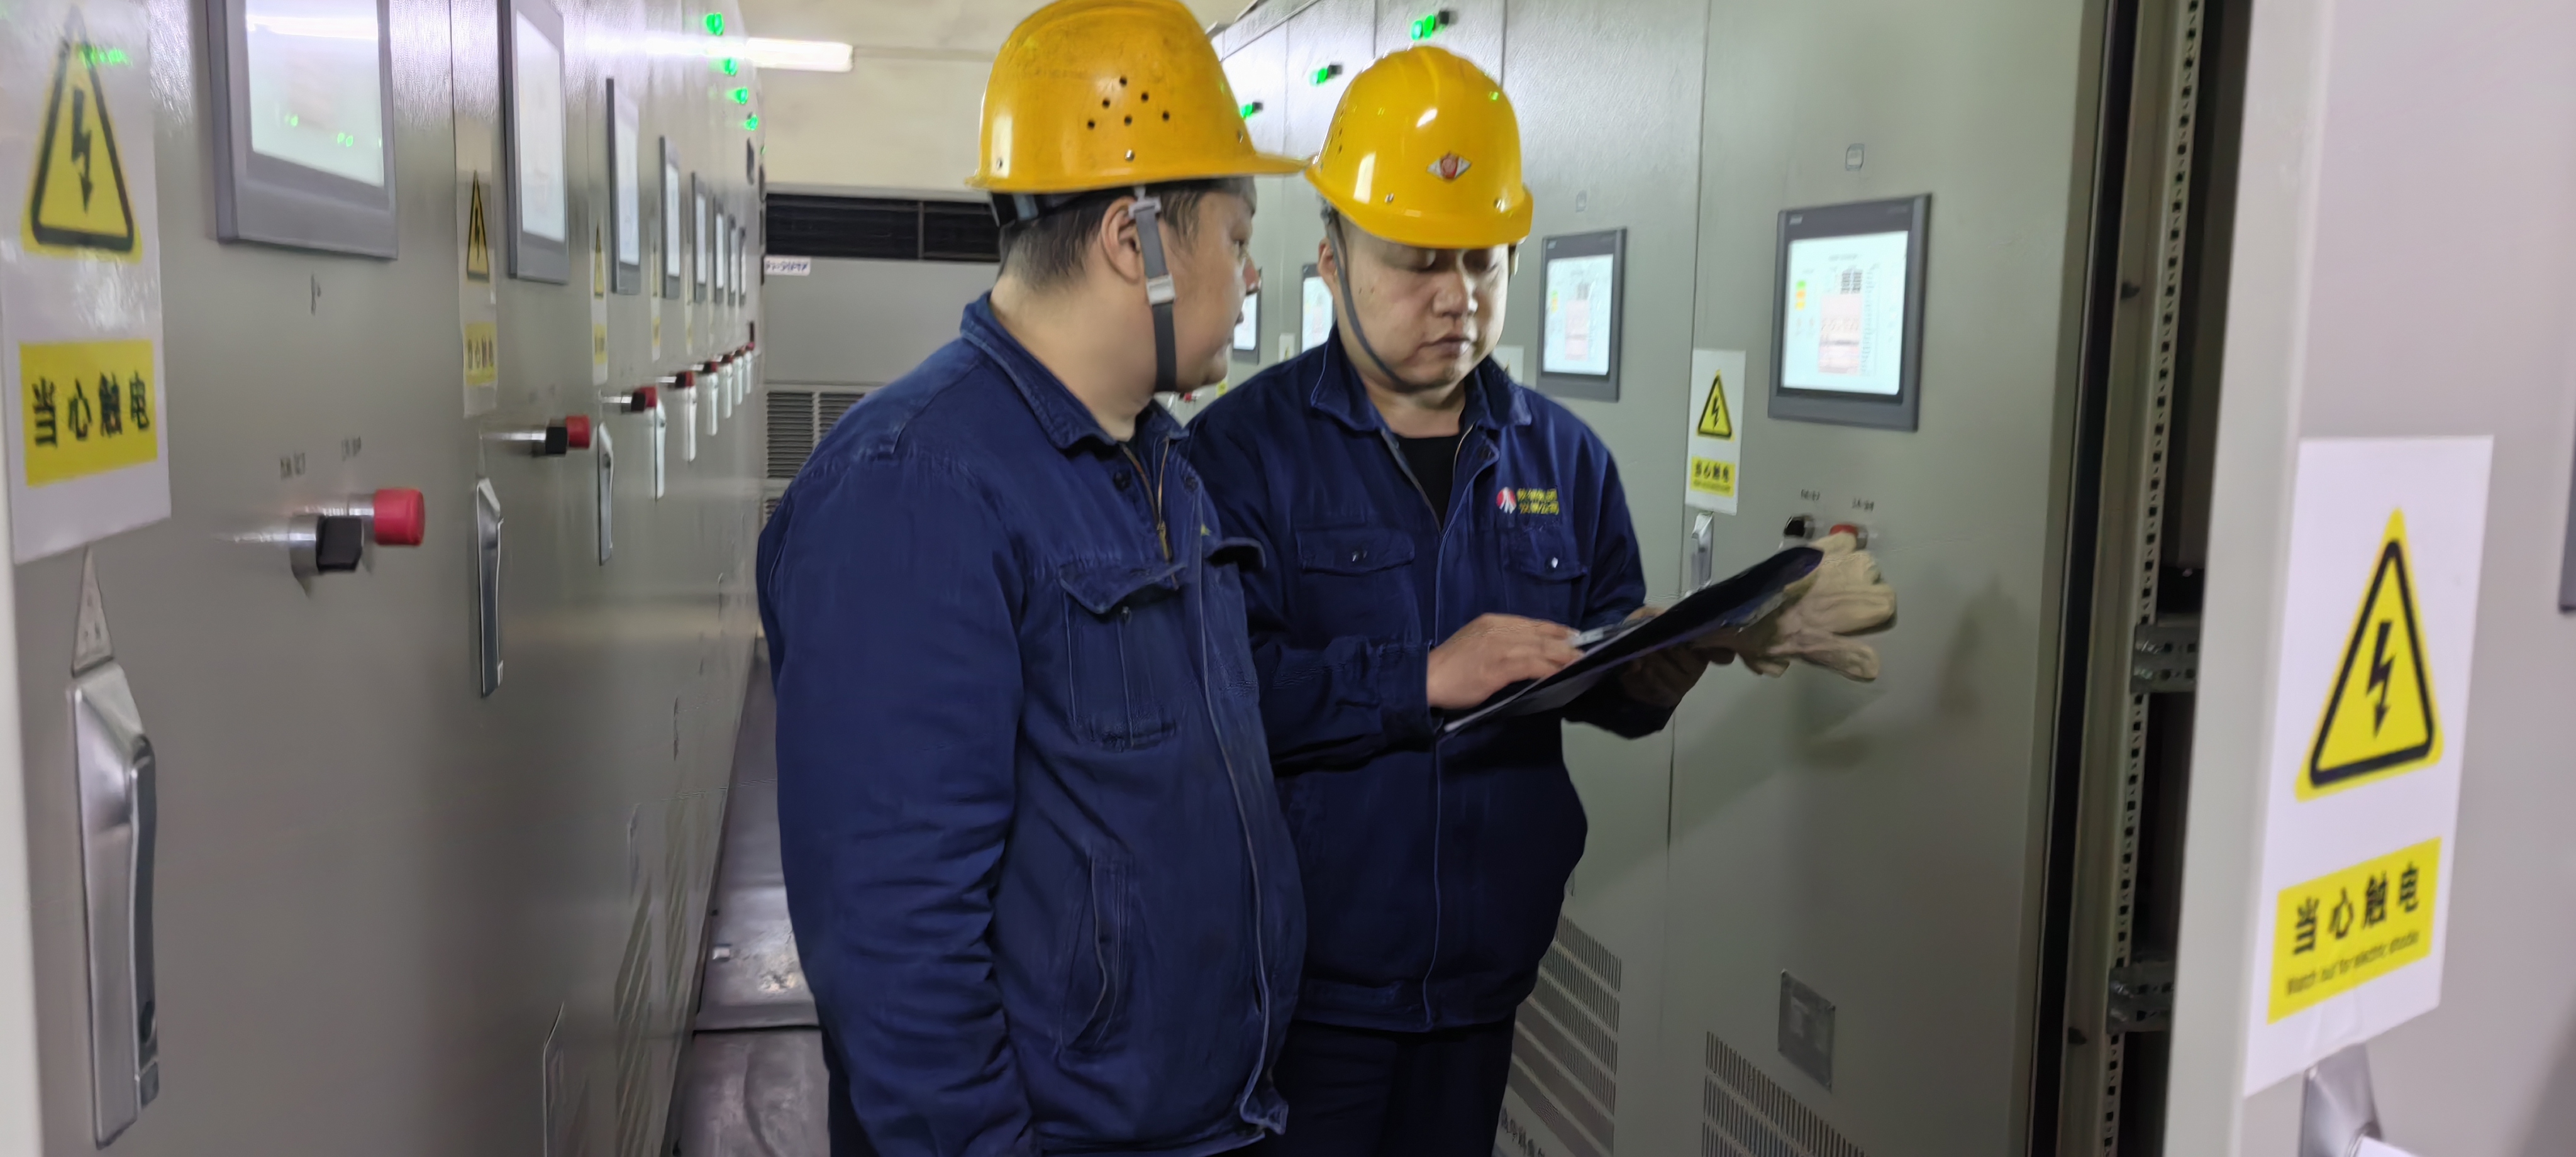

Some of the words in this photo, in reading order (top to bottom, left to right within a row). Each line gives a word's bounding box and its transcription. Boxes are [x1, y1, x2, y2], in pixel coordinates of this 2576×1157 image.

[33, 371, 150, 447] 当心触电
[2293, 861, 2420, 955] 当心触电
